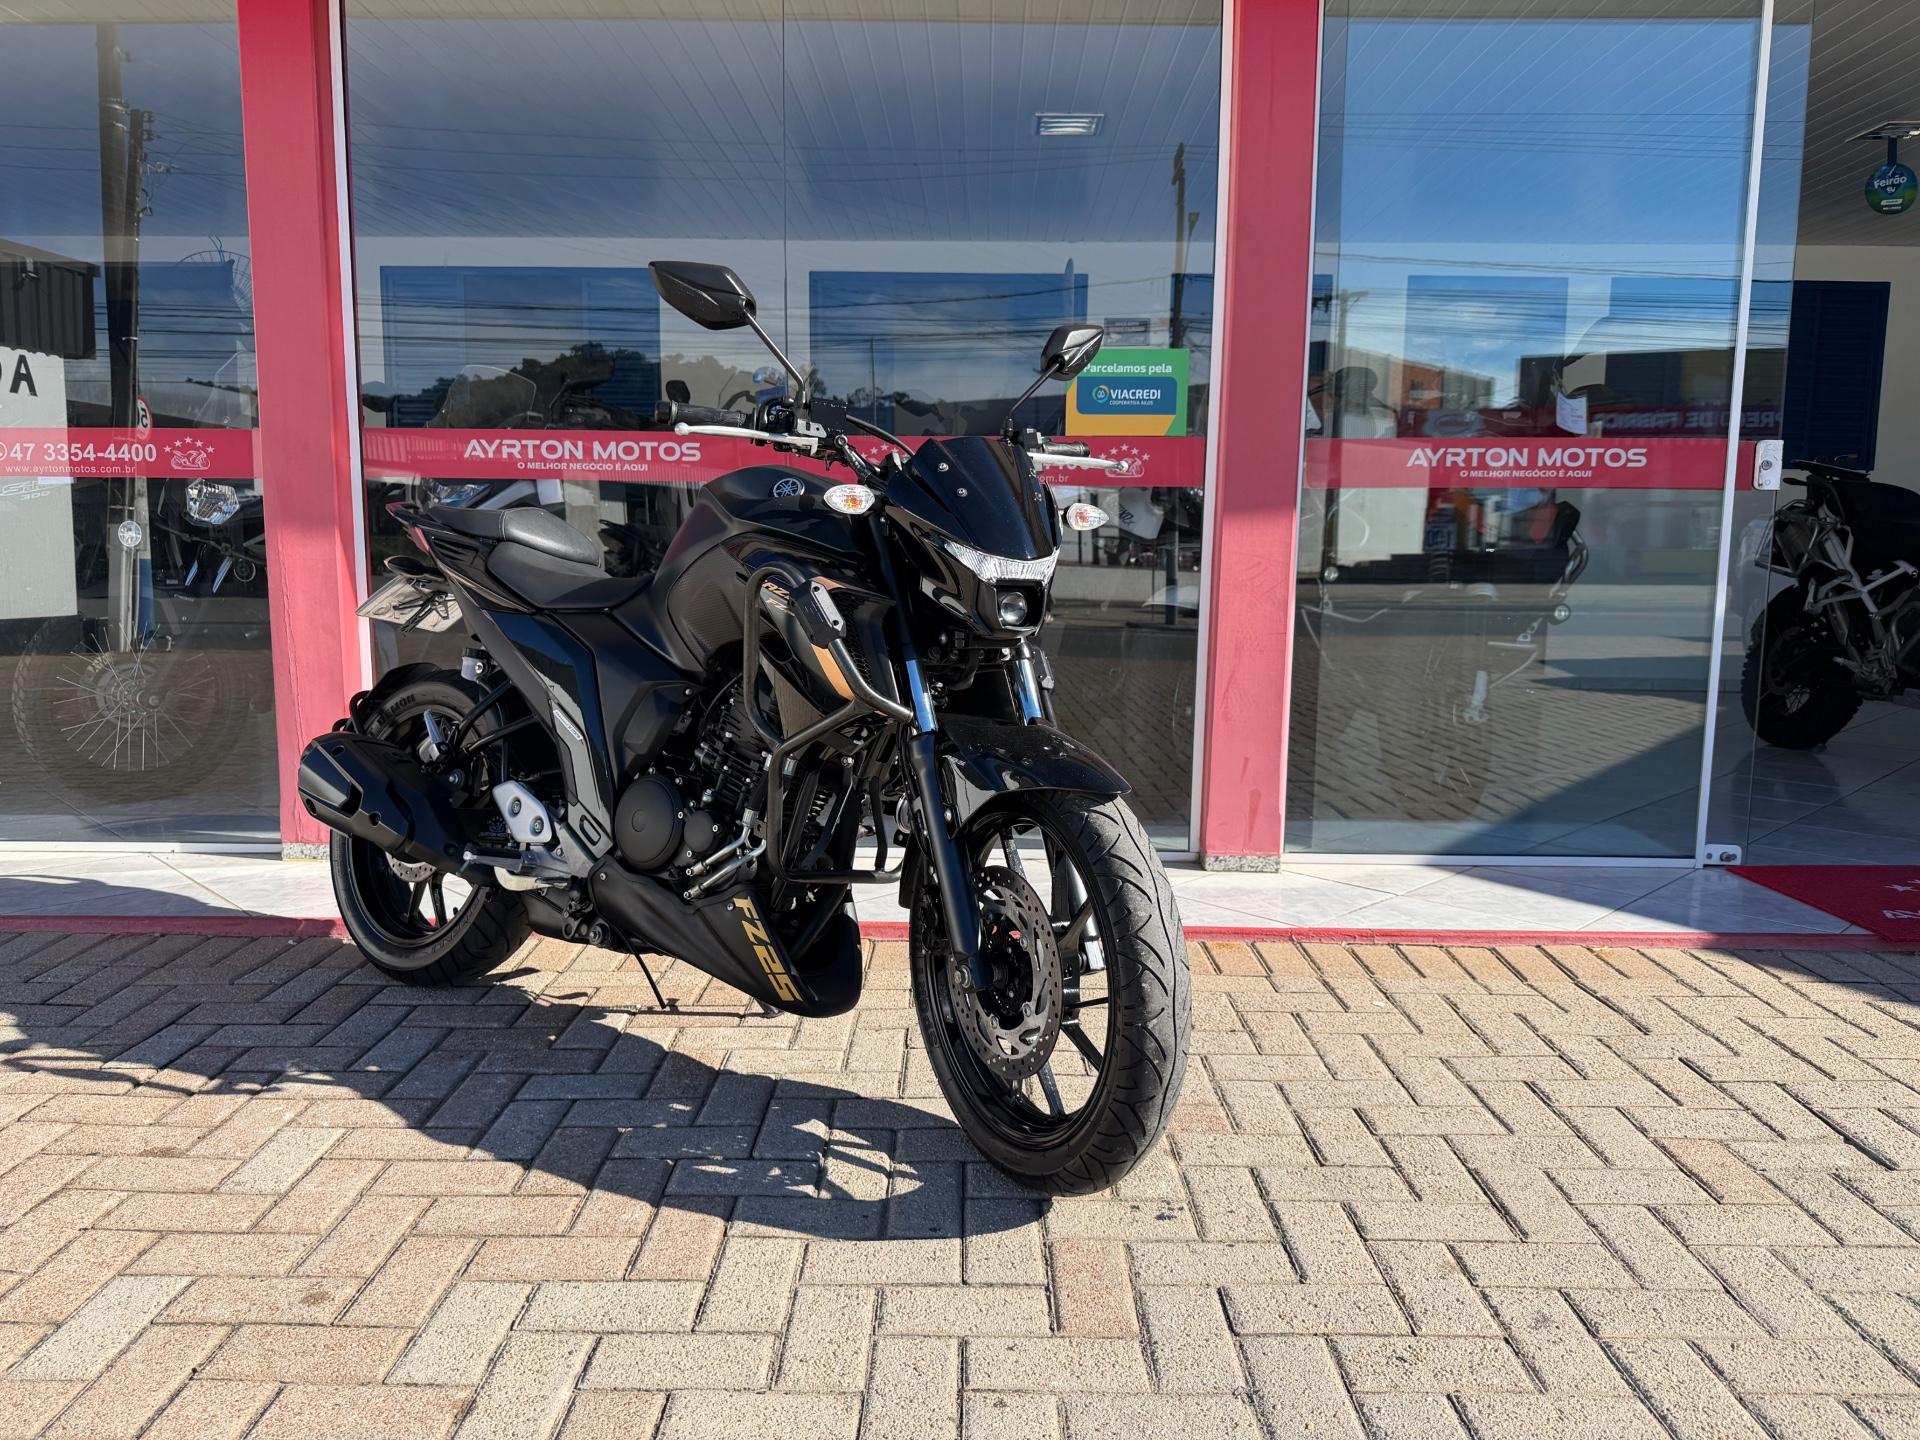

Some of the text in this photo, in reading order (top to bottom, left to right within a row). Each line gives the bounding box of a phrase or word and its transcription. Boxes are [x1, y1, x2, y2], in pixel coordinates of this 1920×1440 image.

[1873, 174, 1908, 189] Feirão
[1083, 363, 1173, 375] Parcelamos pela
[1110, 388, 1161, 400] VIACREDI
[10, 442, 157, 462] 47 3354-4400
[463, 438, 702, 462] AYRTON MOTOS
[1406, 447, 1648, 468] AYRTON MOTOS
[5, 464, 136, 476] www.ayrtonmotos.com.br
[517, 461, 648, 472] O MELHOR NEGÓCIO É AQUI
[1460, 468, 1592, 478] O MELHOR NEGÓCIO É AQUI
[733, 895, 804, 1002] FZ25
